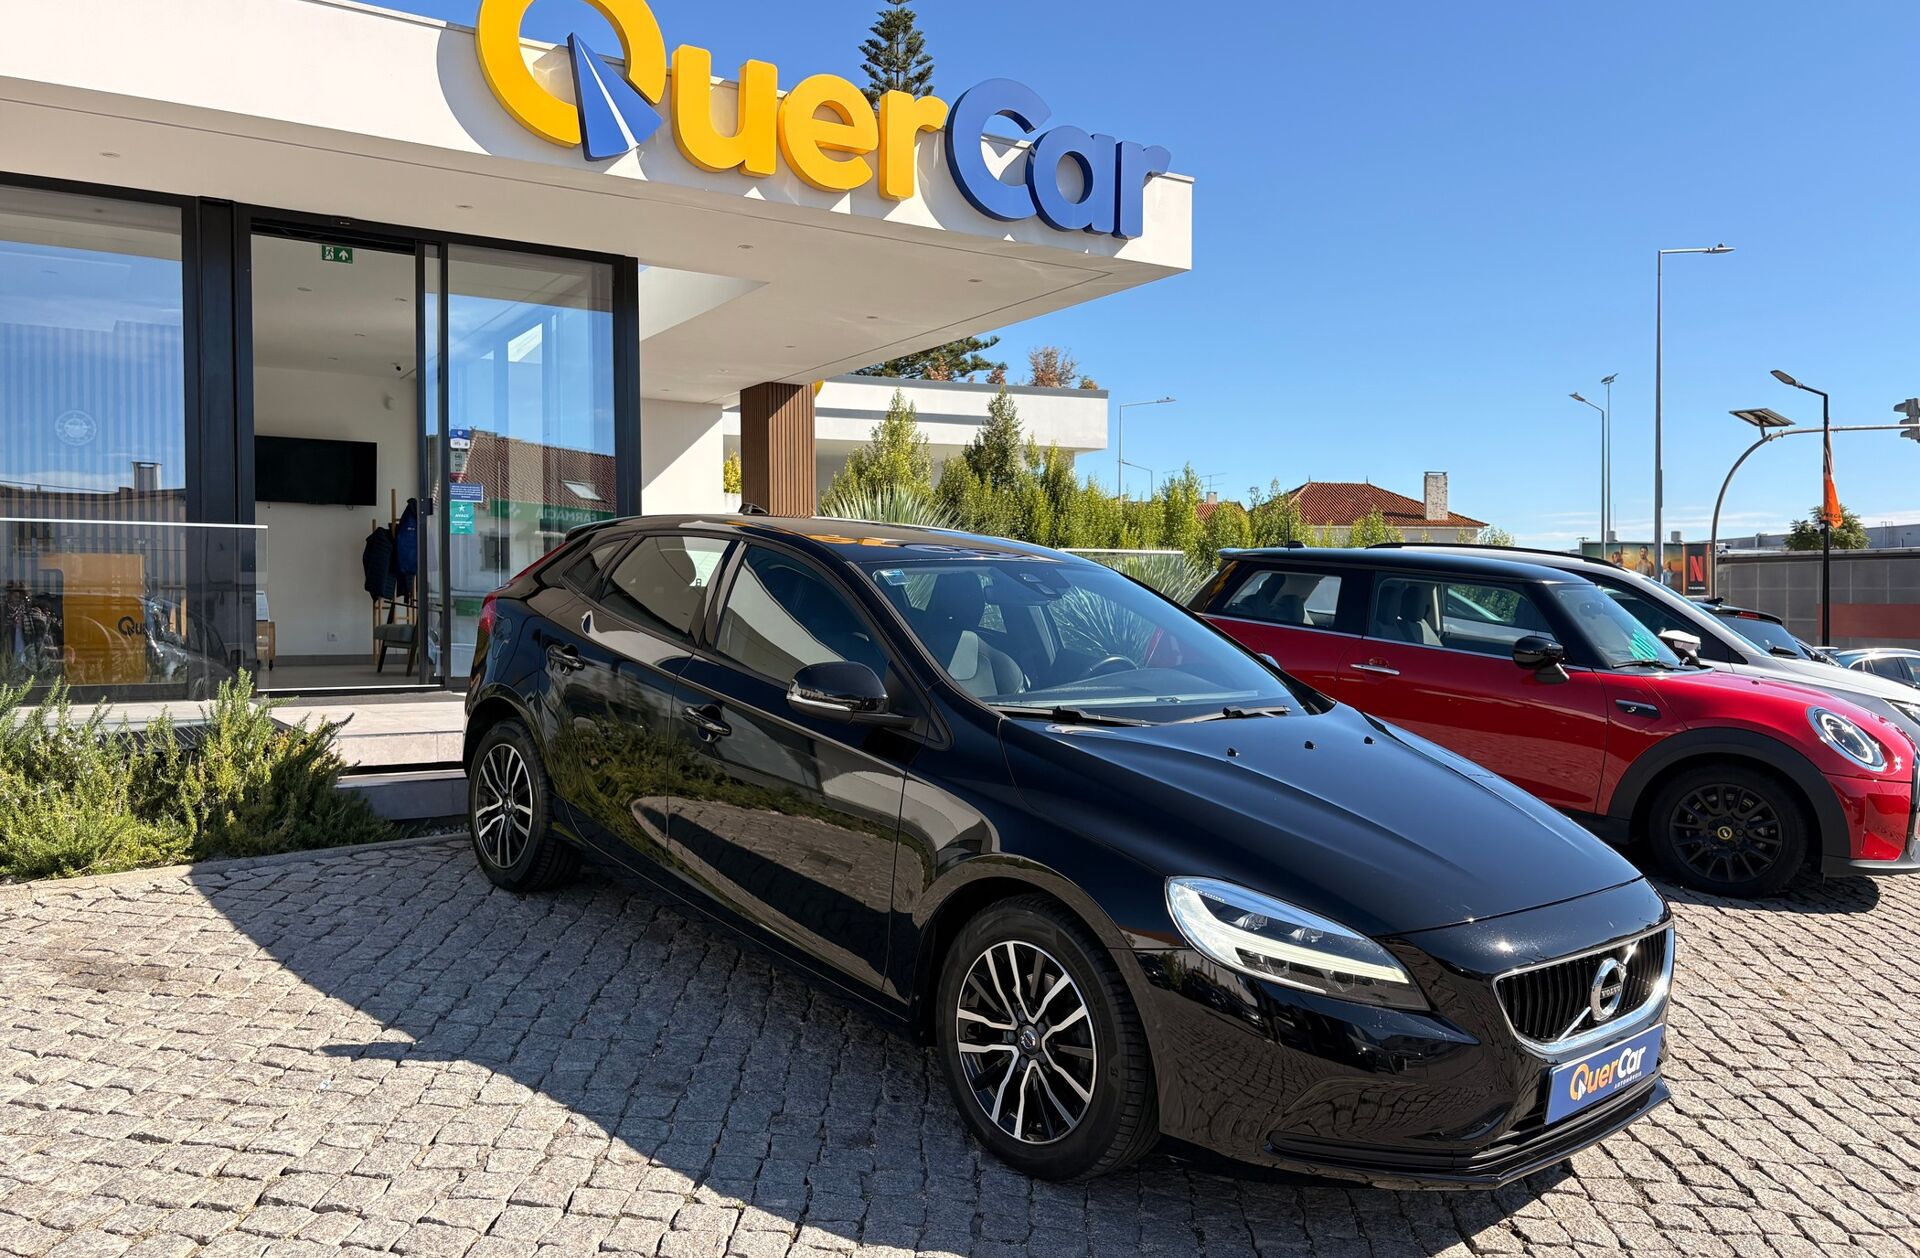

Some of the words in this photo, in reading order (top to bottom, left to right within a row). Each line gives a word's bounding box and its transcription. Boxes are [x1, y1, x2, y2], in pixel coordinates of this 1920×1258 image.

[475, 0, 1171, 239] QuerCar
[1690, 555, 1703, 582] N
[1570, 1046, 1647, 1101] QuerCar
